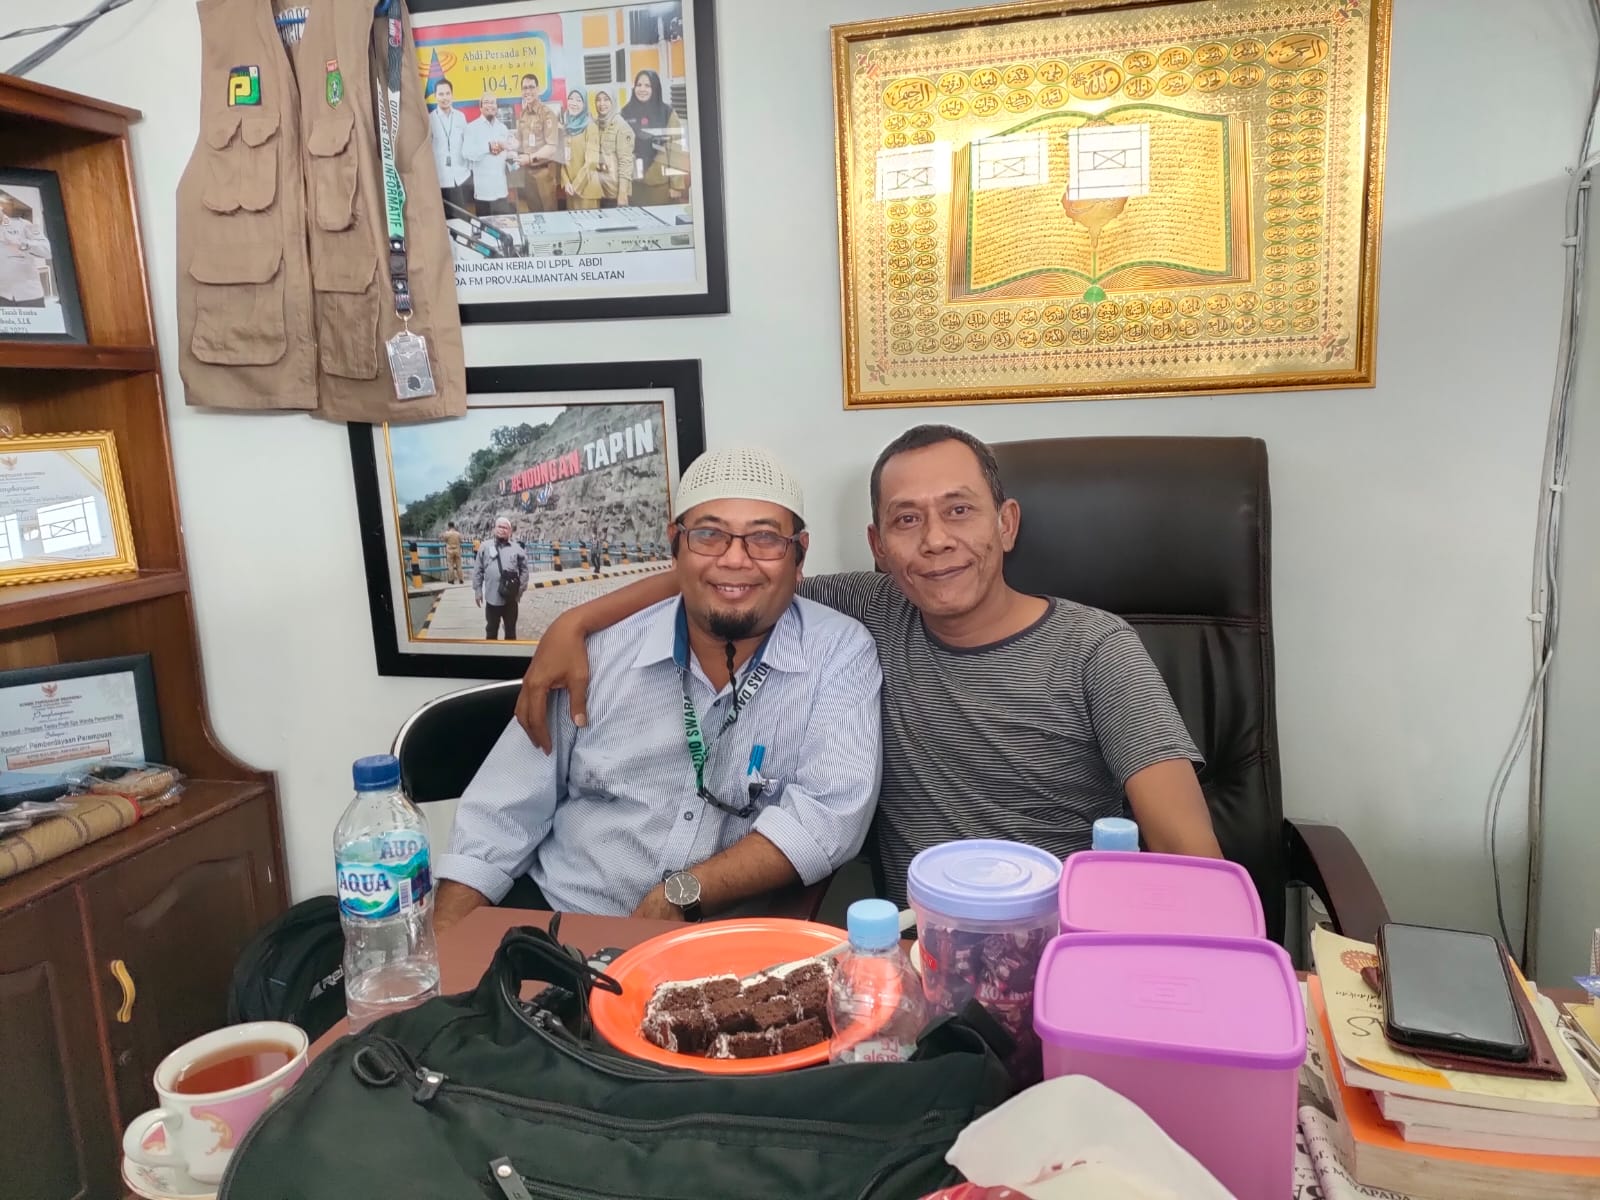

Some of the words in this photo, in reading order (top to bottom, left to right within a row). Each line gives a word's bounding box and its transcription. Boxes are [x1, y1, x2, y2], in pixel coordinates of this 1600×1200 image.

[463, 50, 483, 61] Abdi
[485, 48, 519, 60] Persada
[522, 46, 537, 57] FM
[384, 162, 402, 228] INFORMATIF
[506, 260, 534, 271] KERJA
[536, 260, 547, 270] DI
[549, 258, 574, 269] LPPL
[578, 257, 602, 267] ABDI
[469, 275, 483, 286] FM
[581, 270, 625, 281] SELATAN
[510, 449, 581, 493] BENDUNGAN
[583, 419, 654, 471] TAPIN
[340, 871, 392, 897] AQUA
